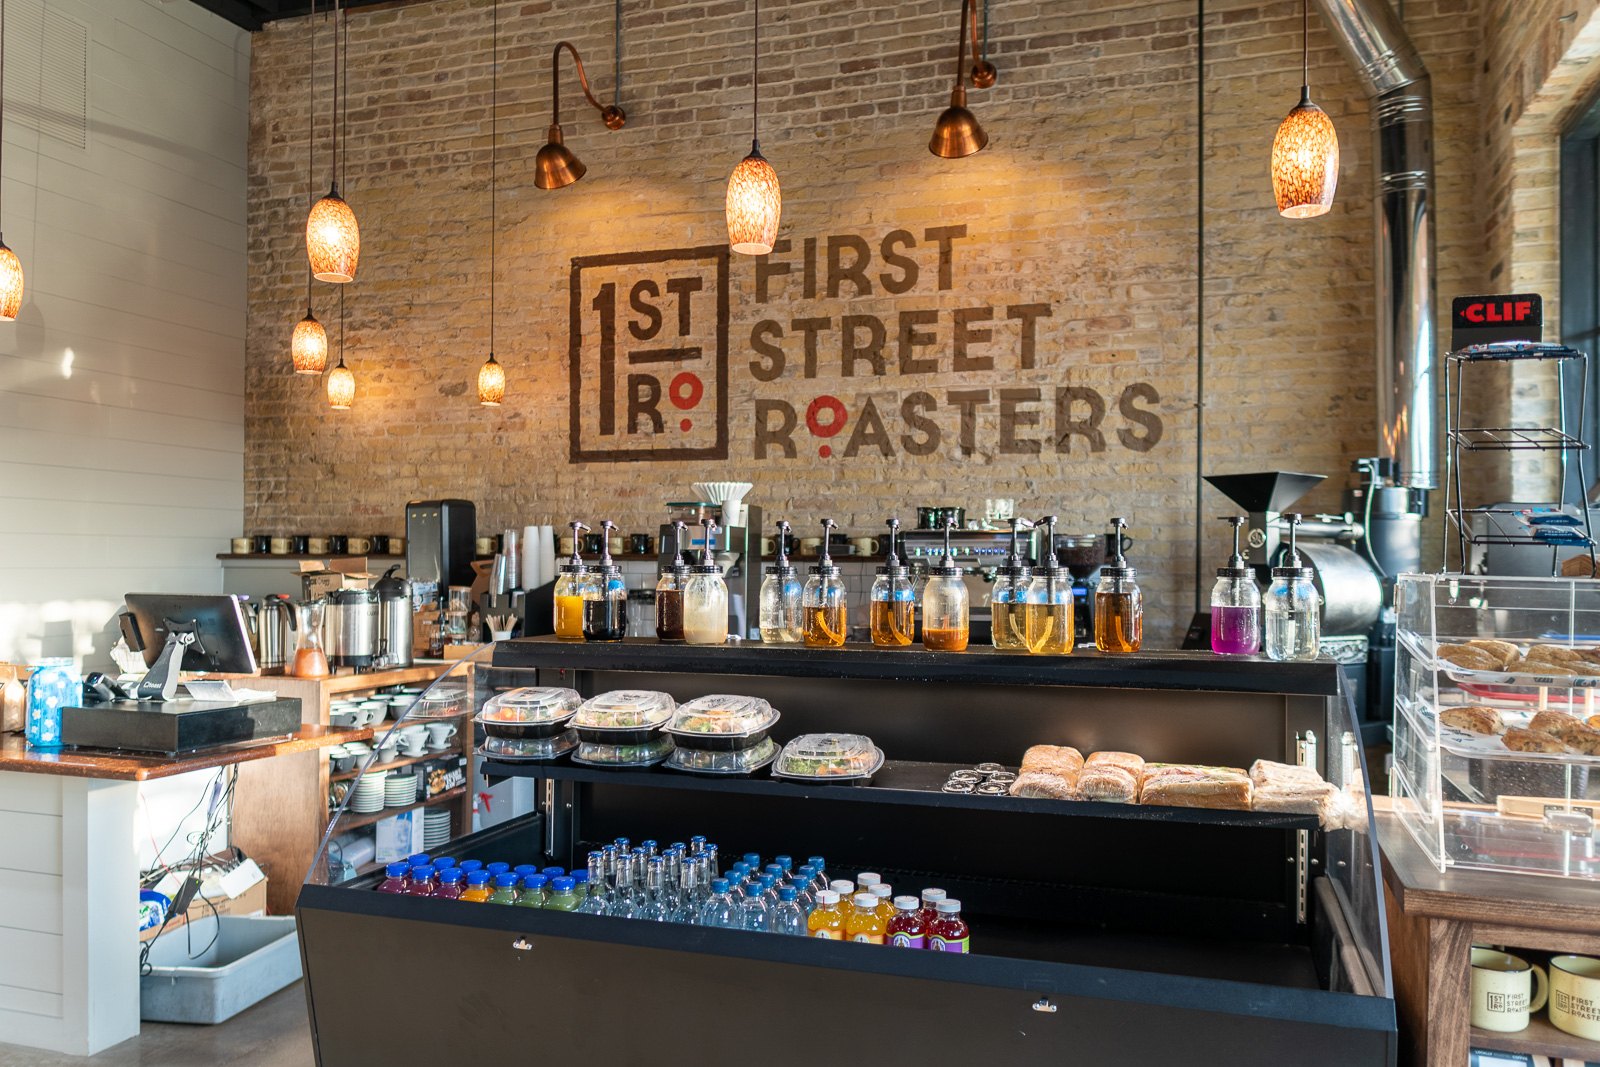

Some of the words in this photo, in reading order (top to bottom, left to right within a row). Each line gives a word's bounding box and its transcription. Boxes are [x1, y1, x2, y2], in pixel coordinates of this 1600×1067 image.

[755, 224, 967, 303] FIRST
[748, 303, 1053, 382] STREET
[1465, 301, 1531, 323] CLIF
[753, 382, 1164, 460] ROASTERS
[1571, 995, 1594, 1007] FIRST
